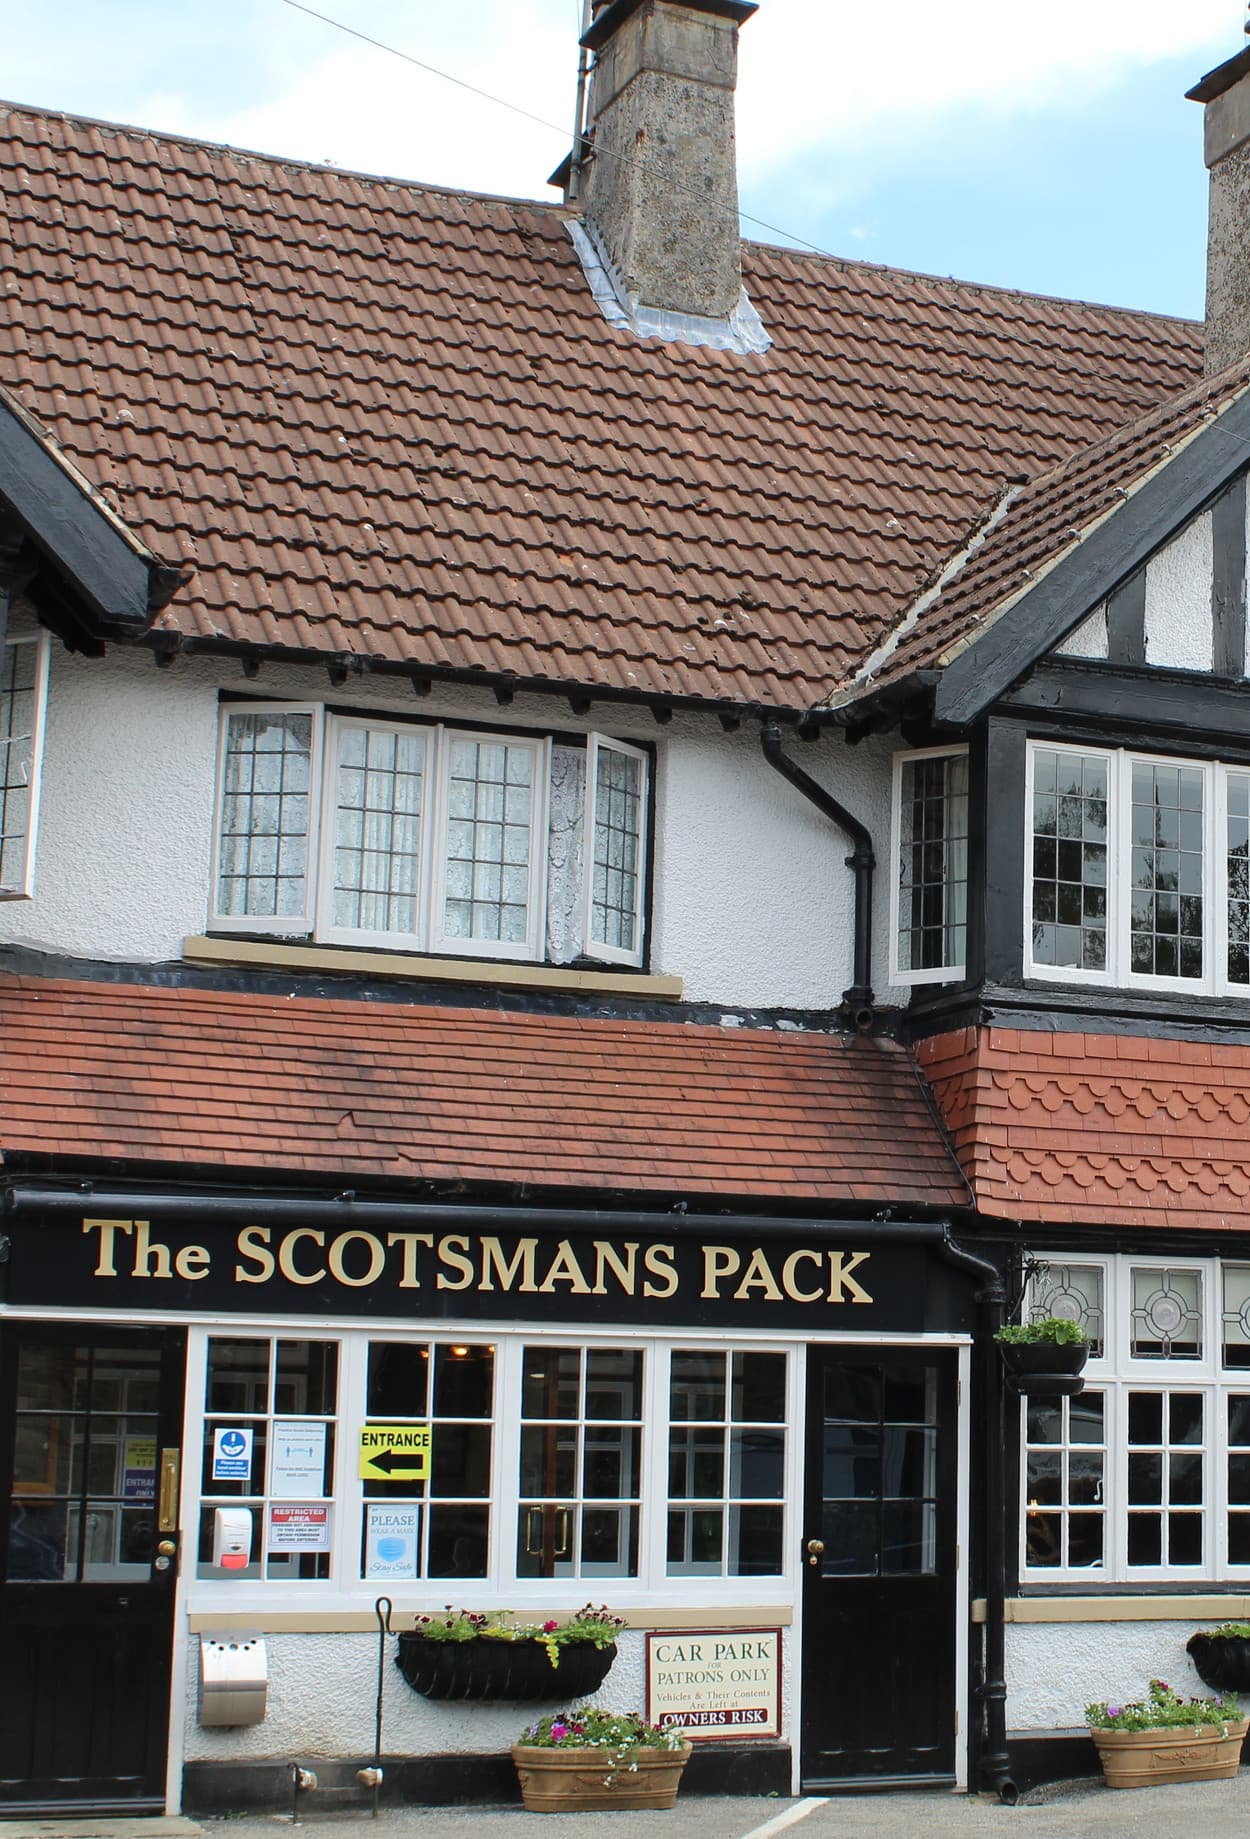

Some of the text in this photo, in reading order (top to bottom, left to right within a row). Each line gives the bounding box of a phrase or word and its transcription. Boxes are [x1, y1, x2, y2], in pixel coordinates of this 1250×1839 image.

[82, 1218, 874, 1304] The SCOTSMANS PACK
[361, 1433, 429, 1446] ENTRANCE
[371, 1515, 415, 1526] PLEASE
[656, 1642, 770, 1662] CAR PARK
[657, 1668, 770, 1685] PATRONS ONLY
[657, 1688, 770, 1702] Vehicles & Their Contents
[689, 1702, 705, 1710] Are
[709, 1701, 727, 1709] Left
[664, 1710, 764, 1726] OWNERS RISK
